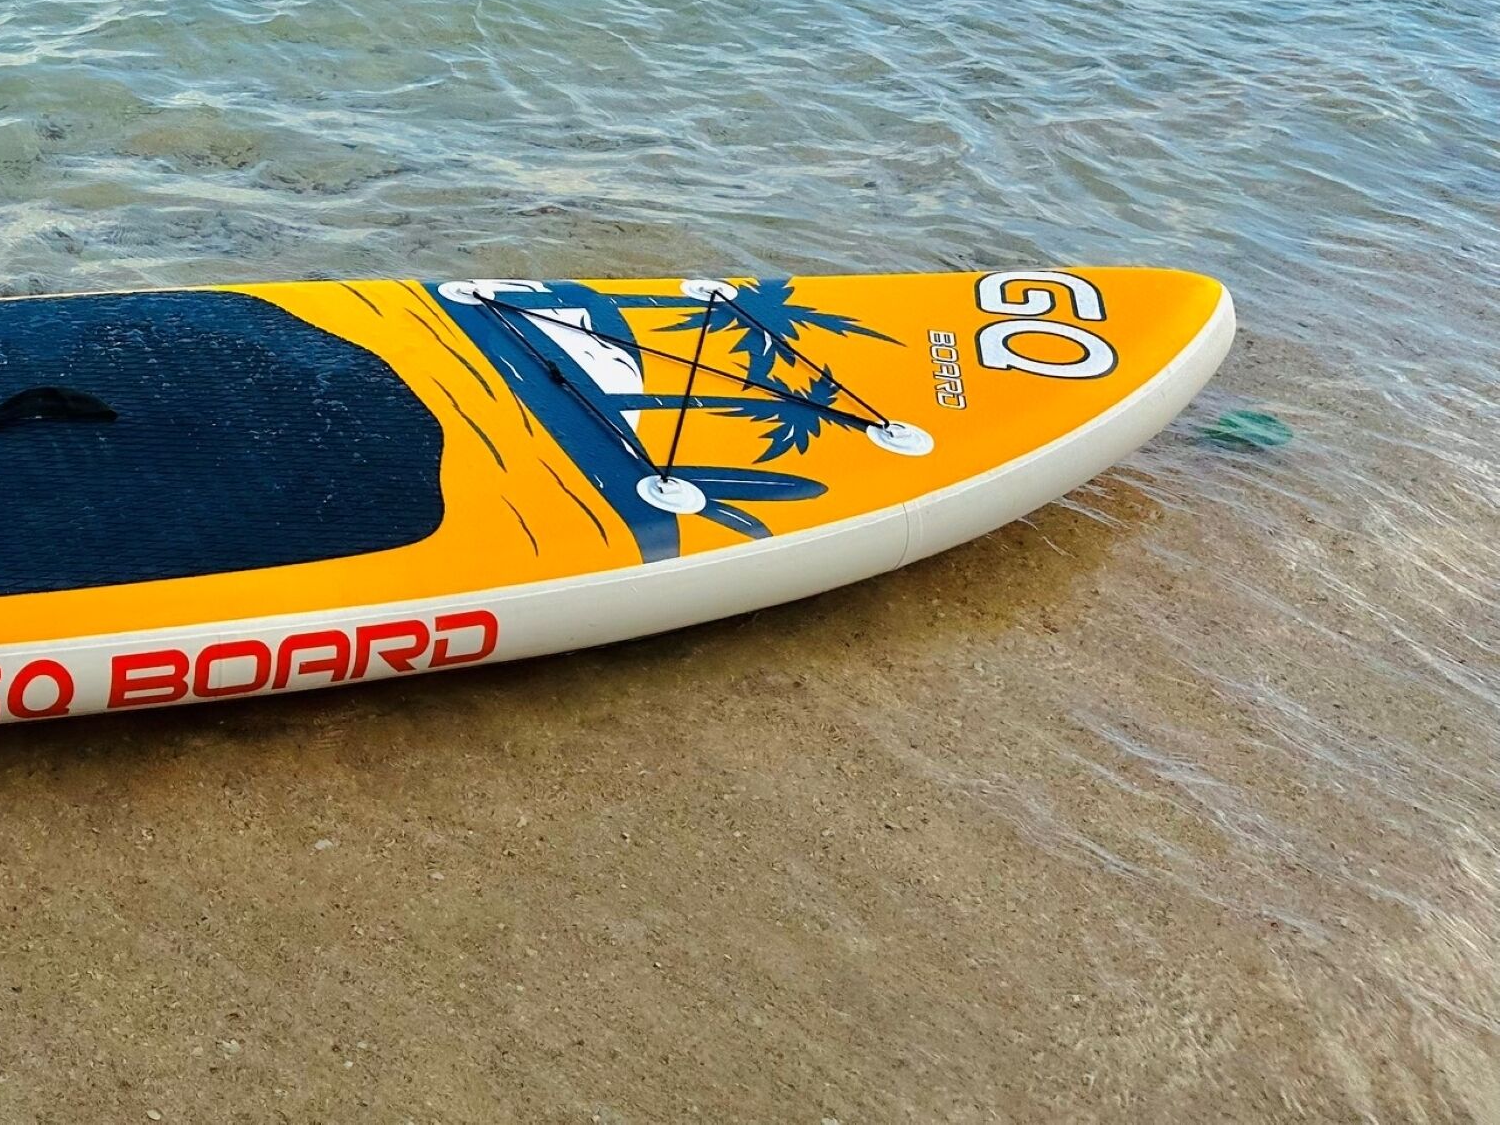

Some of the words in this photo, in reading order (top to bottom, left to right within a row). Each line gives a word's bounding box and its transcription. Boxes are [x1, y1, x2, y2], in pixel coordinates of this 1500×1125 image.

[927, 330, 967, 410] BOARD
[974, 270, 1119, 379] GQ
[108, 611, 498, 708] BOARD
